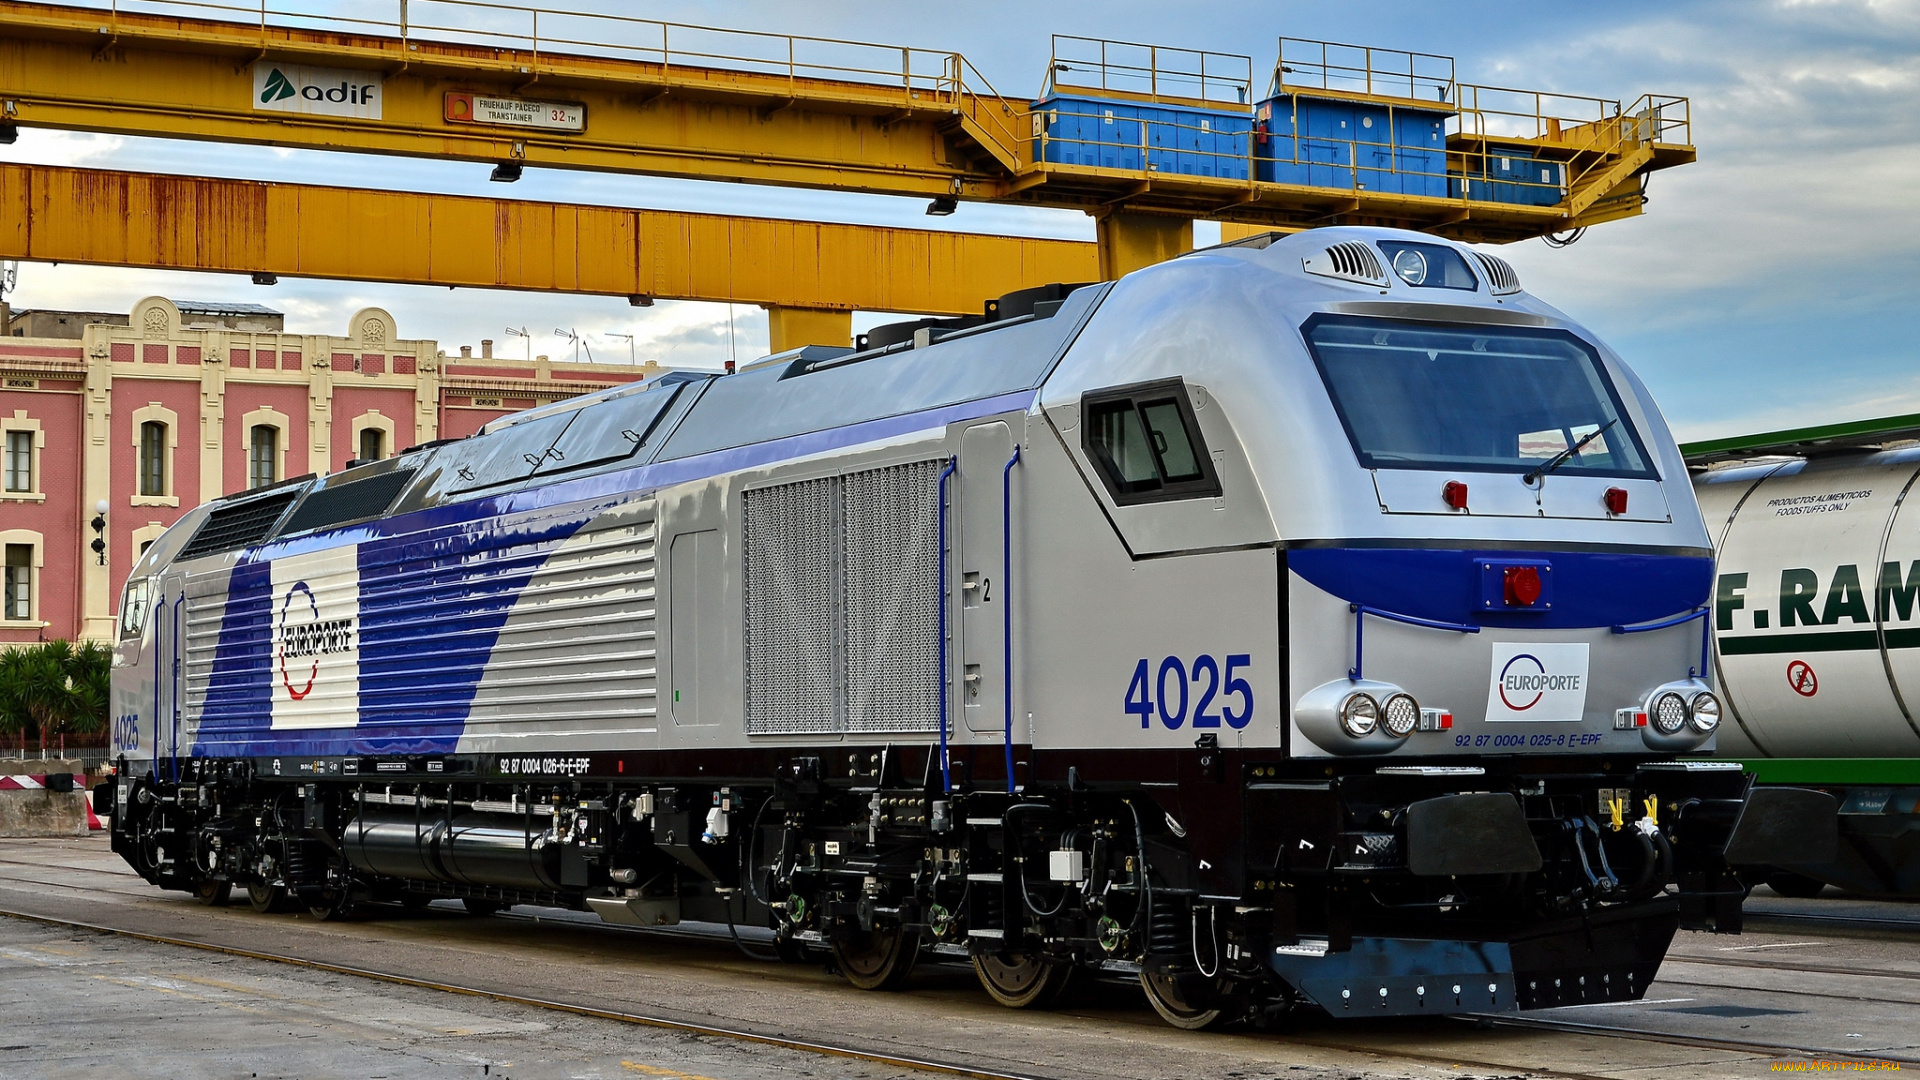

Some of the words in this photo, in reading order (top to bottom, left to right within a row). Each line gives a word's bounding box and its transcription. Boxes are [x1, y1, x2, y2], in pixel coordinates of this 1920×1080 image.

[301, 81, 376, 105] adif
[479, 99, 513, 110] FRUEHAUF
[515, 103, 541, 113] PACECO
[488, 111, 533, 123] TRANSTAINER
[551, 109, 566, 122] 32
[1767, 495, 1816, 507] PRODUCTOS
[1815, 490, 1872, 504] ALIMENTICIOS
[1775, 504, 1828, 517] FOODSTUFFS
[1827, 502, 1851, 512] ONLY
[983, 577, 991, 602] 2
[1505, 674, 1581, 691] EUROPORTE
[1124, 653, 1255, 730] 4025
[113, 714, 139, 751] 4025
[1455, 734, 1471, 747] 92
[1474, 734, 1491, 747] 87
[1494, 734, 1525, 747] 0004
[1529, 734, 1565, 746] 025-8
[500, 758, 510, 774] 92
[511, 758, 520, 774] 87
[521, 758, 540, 774] 0004
